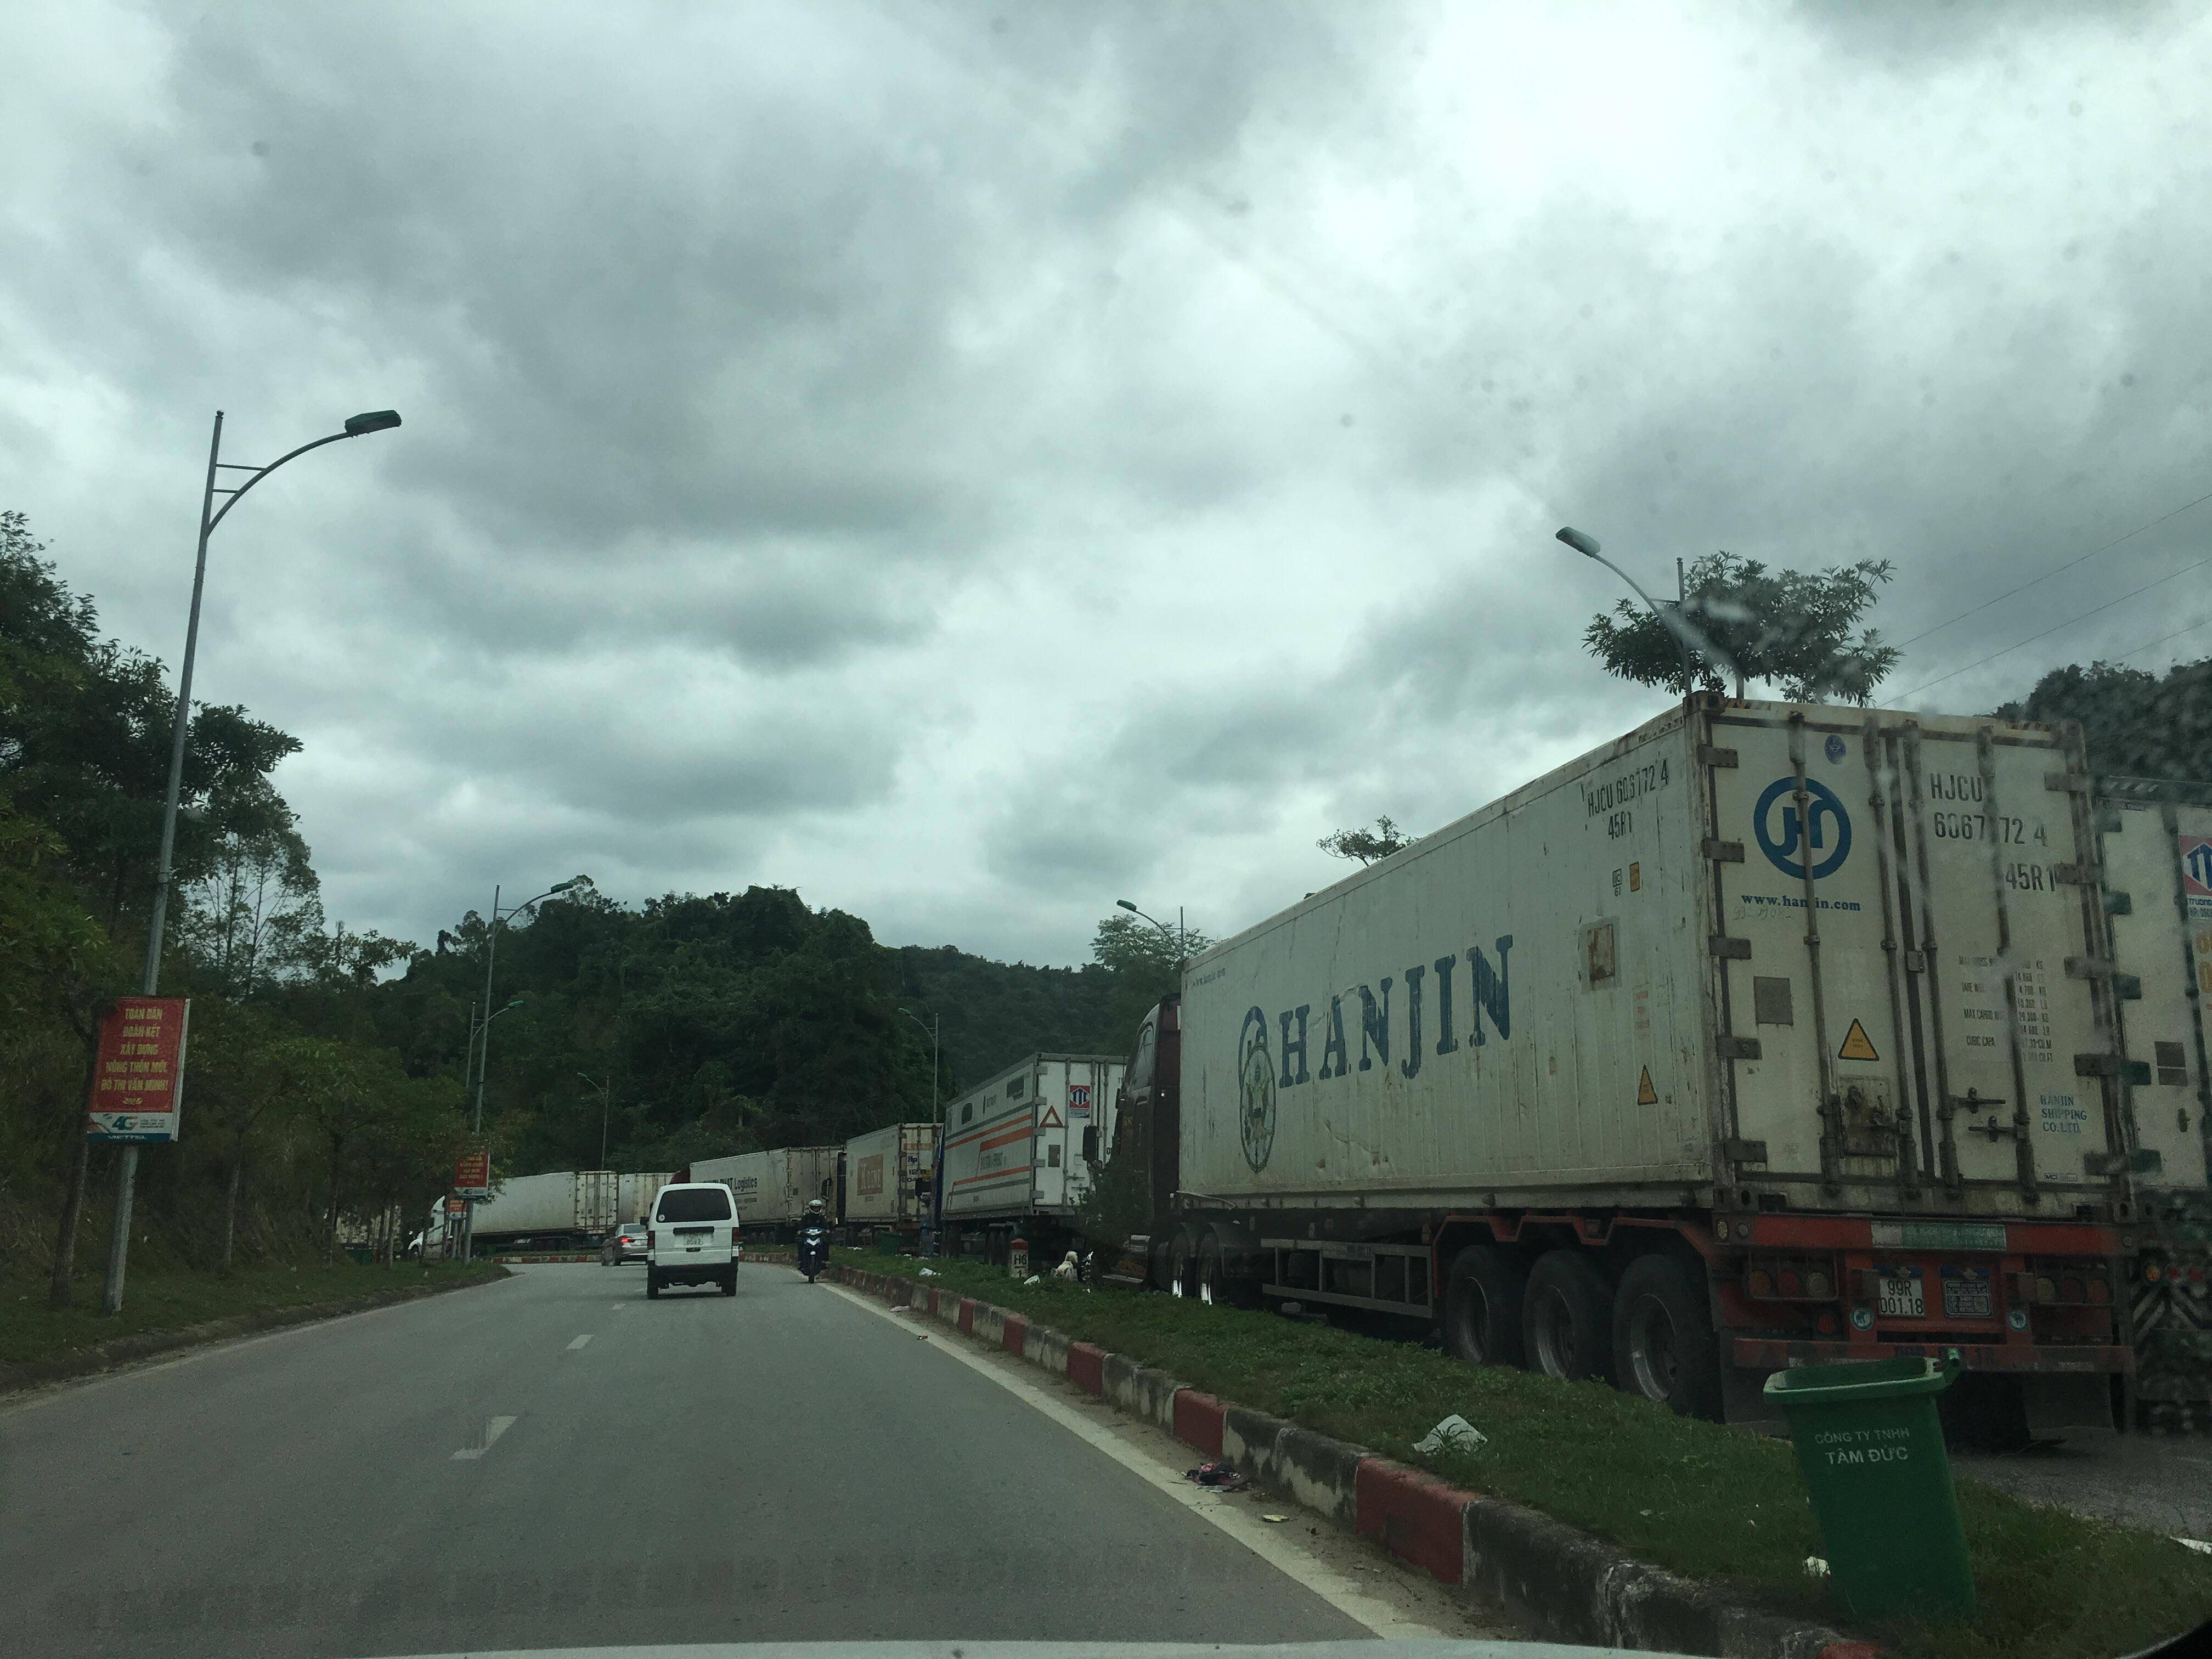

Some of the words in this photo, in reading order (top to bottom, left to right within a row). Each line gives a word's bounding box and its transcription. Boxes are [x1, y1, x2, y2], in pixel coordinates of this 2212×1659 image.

[1930, 772, 1983, 802] HJCU
[1588, 783, 1613, 817] HJCU
[2005, 862, 2056, 891] 45R1
[1741, 895, 1861, 912] www.hanin.com
[1278, 934, 1514, 1090] HANJIN
[734, 1177, 758, 1192] Logistics
[1014, 1254, 1027, 1265] H6
[1887, 1280, 1912, 1296] 99R
[1880, 1297, 1925, 1315] 001.18
[1814, 1431, 1853, 1444] CÔNG
[1854, 1430, 1870, 1441] TY
[1873, 1427, 1910, 1440] TNHH
[1824, 1447, 1864, 1465] TÂM
